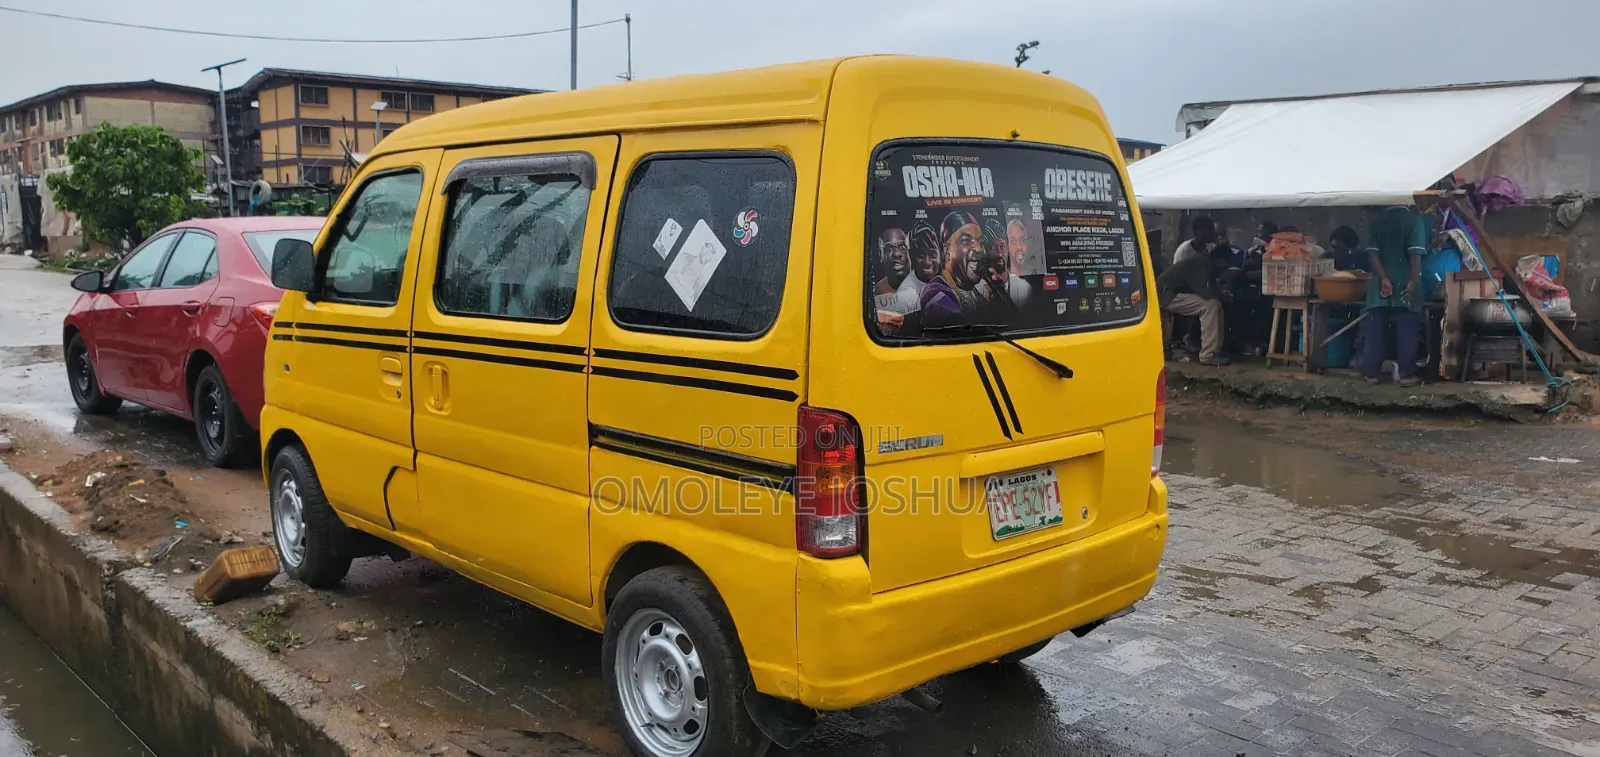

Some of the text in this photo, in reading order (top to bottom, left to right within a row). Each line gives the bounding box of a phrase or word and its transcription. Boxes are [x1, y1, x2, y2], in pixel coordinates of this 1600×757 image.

[1044, 168, 1113, 202] OBESERE
[951, 197, 984, 205] CONCERT
[1007, 474, 1037, 486] LAGOS
